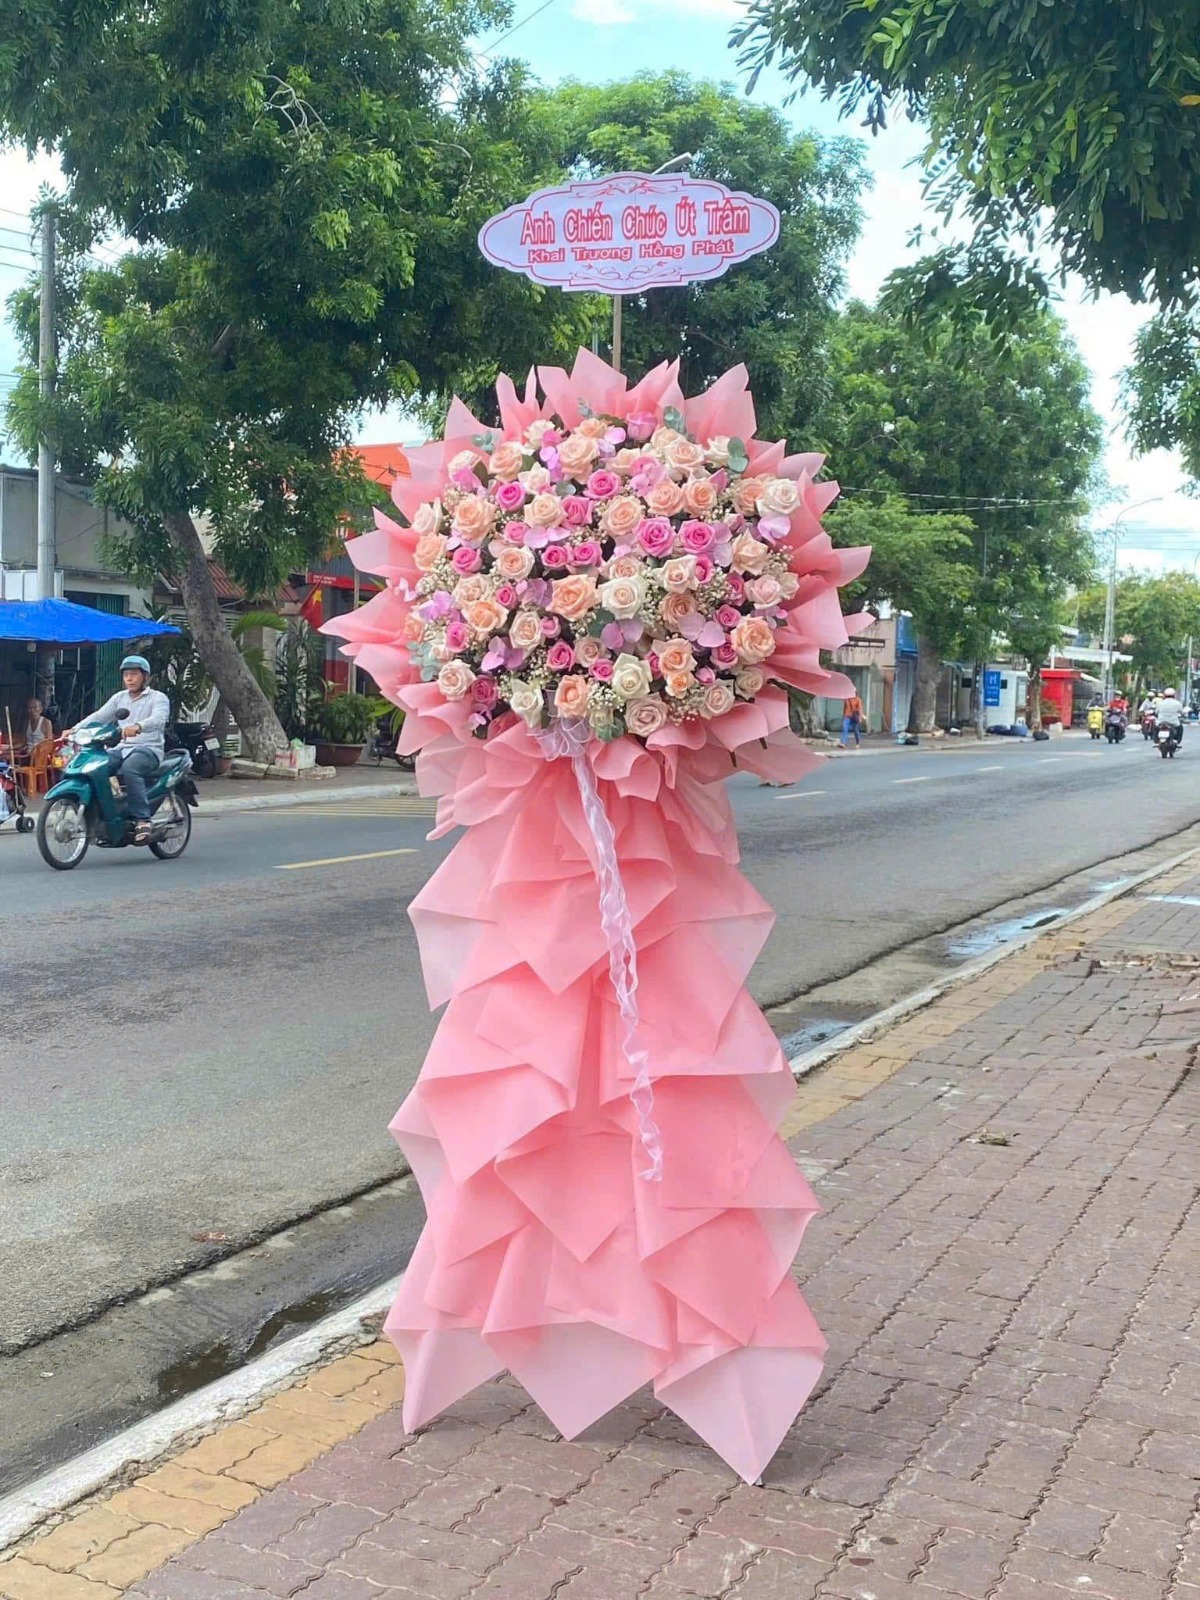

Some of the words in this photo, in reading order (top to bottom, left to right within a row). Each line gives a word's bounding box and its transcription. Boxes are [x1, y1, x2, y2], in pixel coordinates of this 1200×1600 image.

[520, 211, 555, 246] Anh
[563, 201, 613, 243] Chiến
[622, 204, 667, 240] Chúc
[676, 195, 697, 237] Út
[704, 200, 750, 236] Trâm
[528, 247, 566, 263] Khai
[571, 246, 632, 262] Trương
[639, 241, 685, 259] Hồng
[692, 239, 734, 256] Phát
